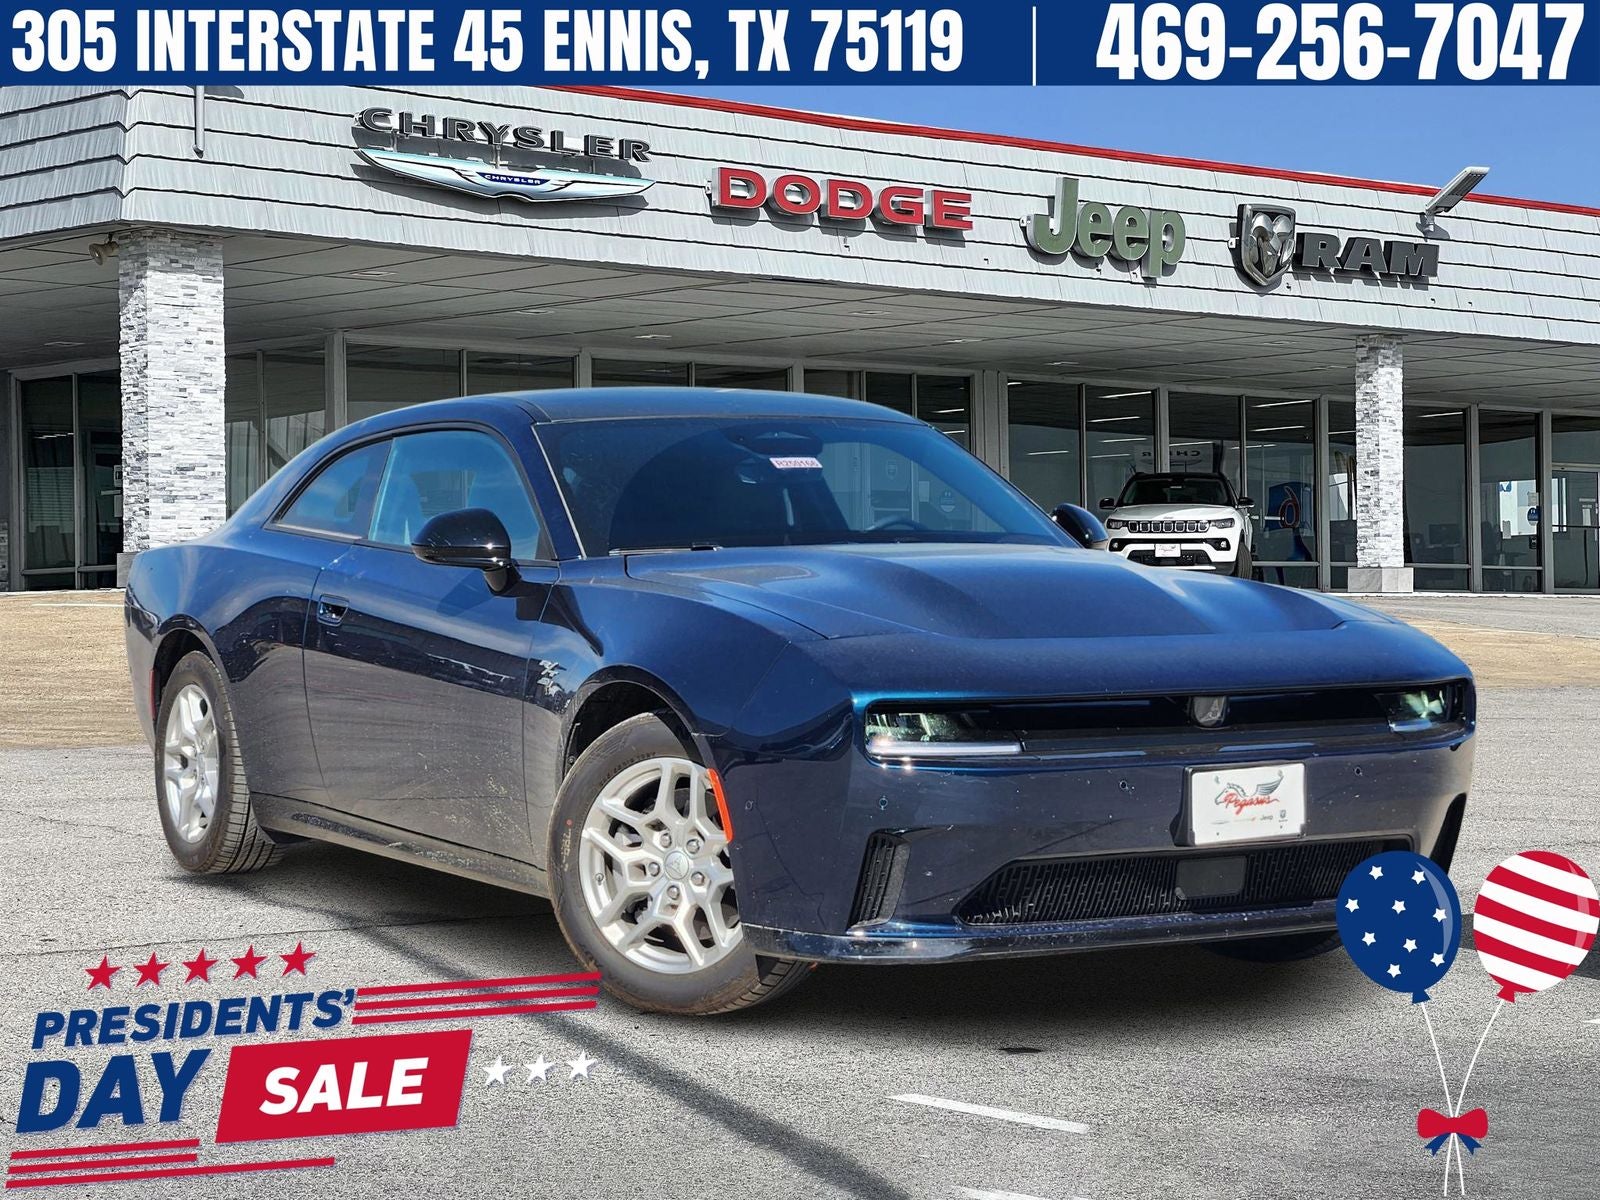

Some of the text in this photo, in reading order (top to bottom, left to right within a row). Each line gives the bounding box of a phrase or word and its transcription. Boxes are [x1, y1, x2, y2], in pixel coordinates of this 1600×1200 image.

[358, 106, 651, 162] CHRYSLER
[484, 174, 541, 184] CHRYSLER
[714, 167, 973, 231] DODGE
[1029, 177, 1185, 277] Jeep
[1298, 232, 1439, 278] RAM
